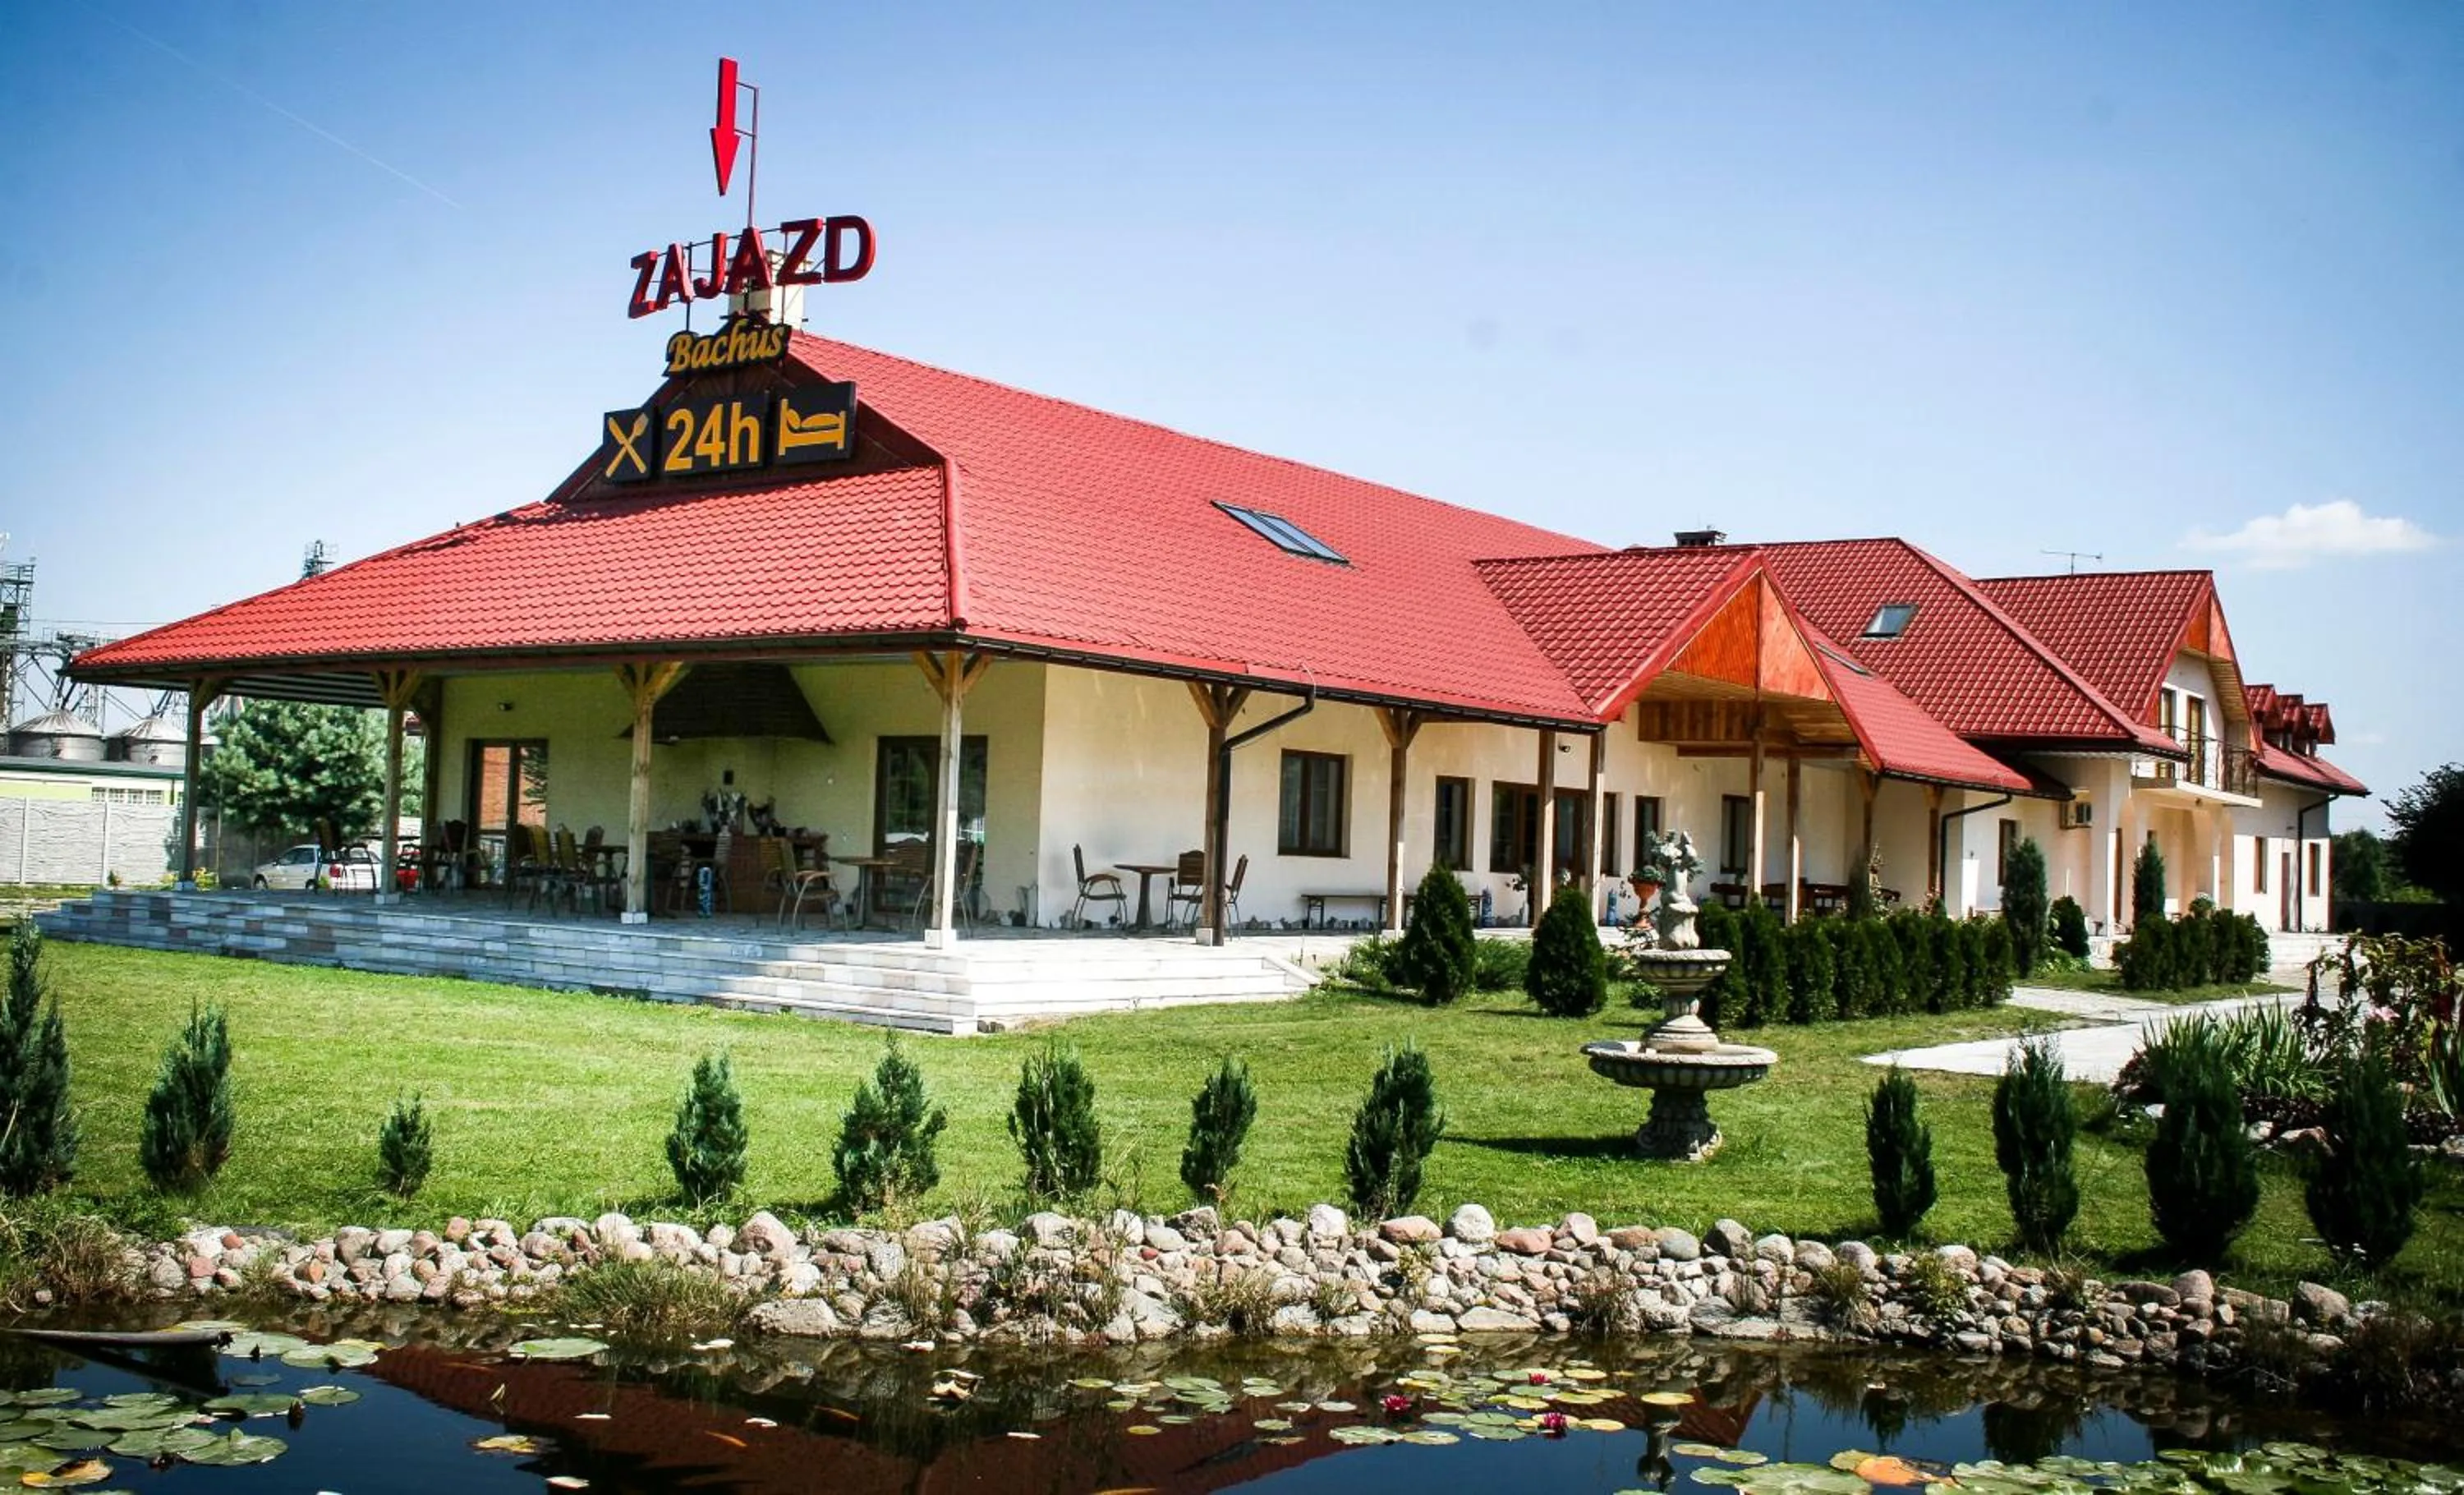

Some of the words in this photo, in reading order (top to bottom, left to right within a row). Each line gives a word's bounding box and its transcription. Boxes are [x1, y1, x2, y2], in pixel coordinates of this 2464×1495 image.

[628, 214, 876, 319] ZAJAZD
[668, 318, 784, 372] Bachus
[664, 401, 760, 472] 24h
